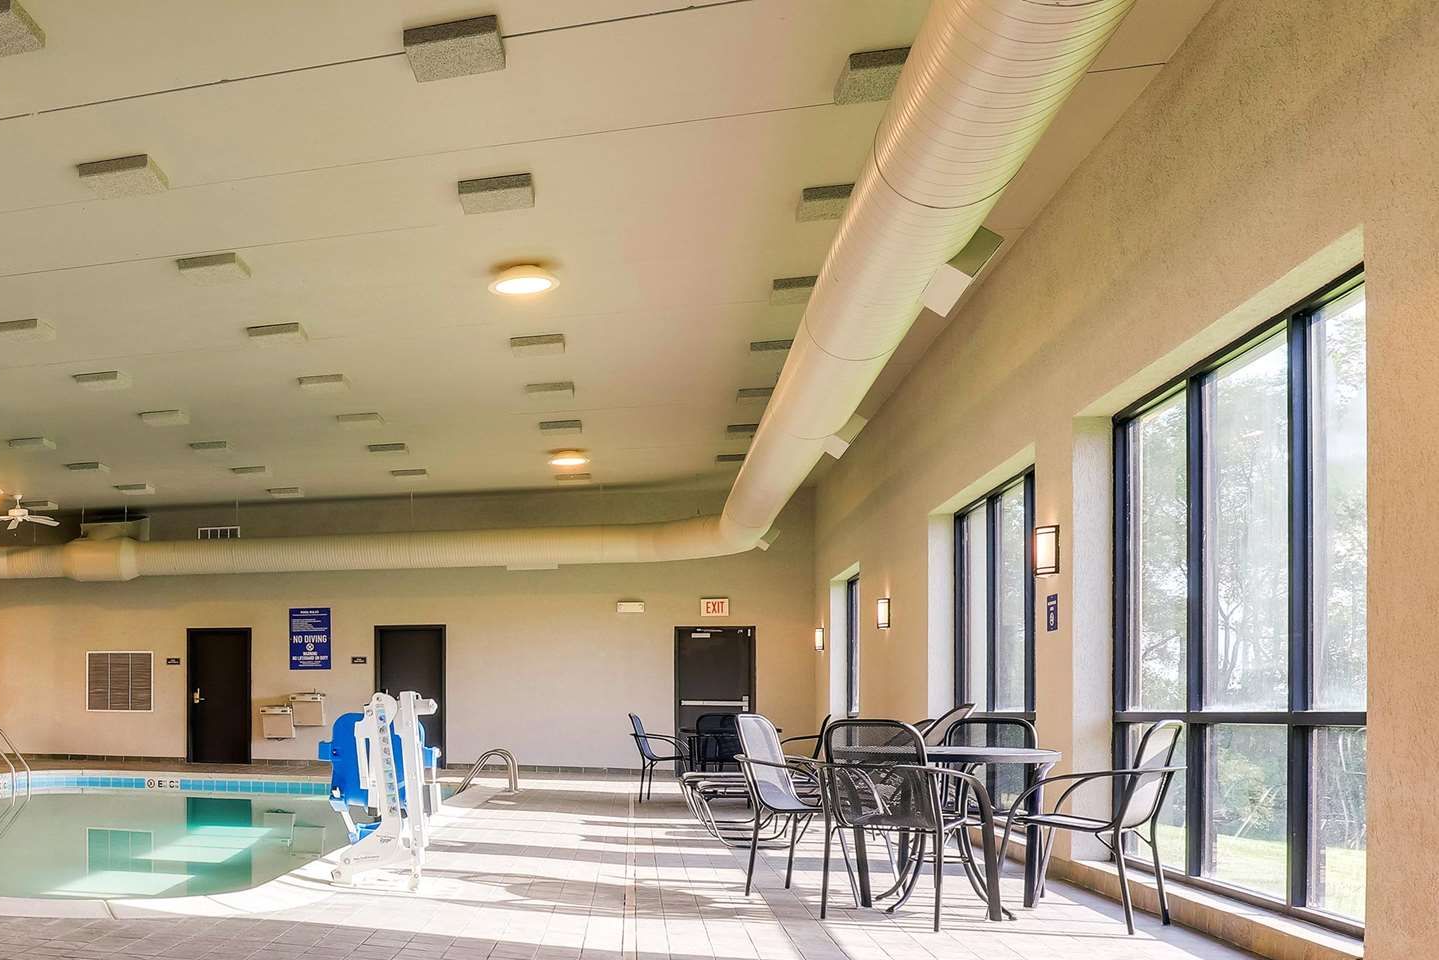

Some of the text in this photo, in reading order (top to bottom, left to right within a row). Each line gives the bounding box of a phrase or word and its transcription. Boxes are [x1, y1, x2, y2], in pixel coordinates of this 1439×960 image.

[706, 601, 724, 614] EXIT
[293, 634, 328, 643] NO DIVING
